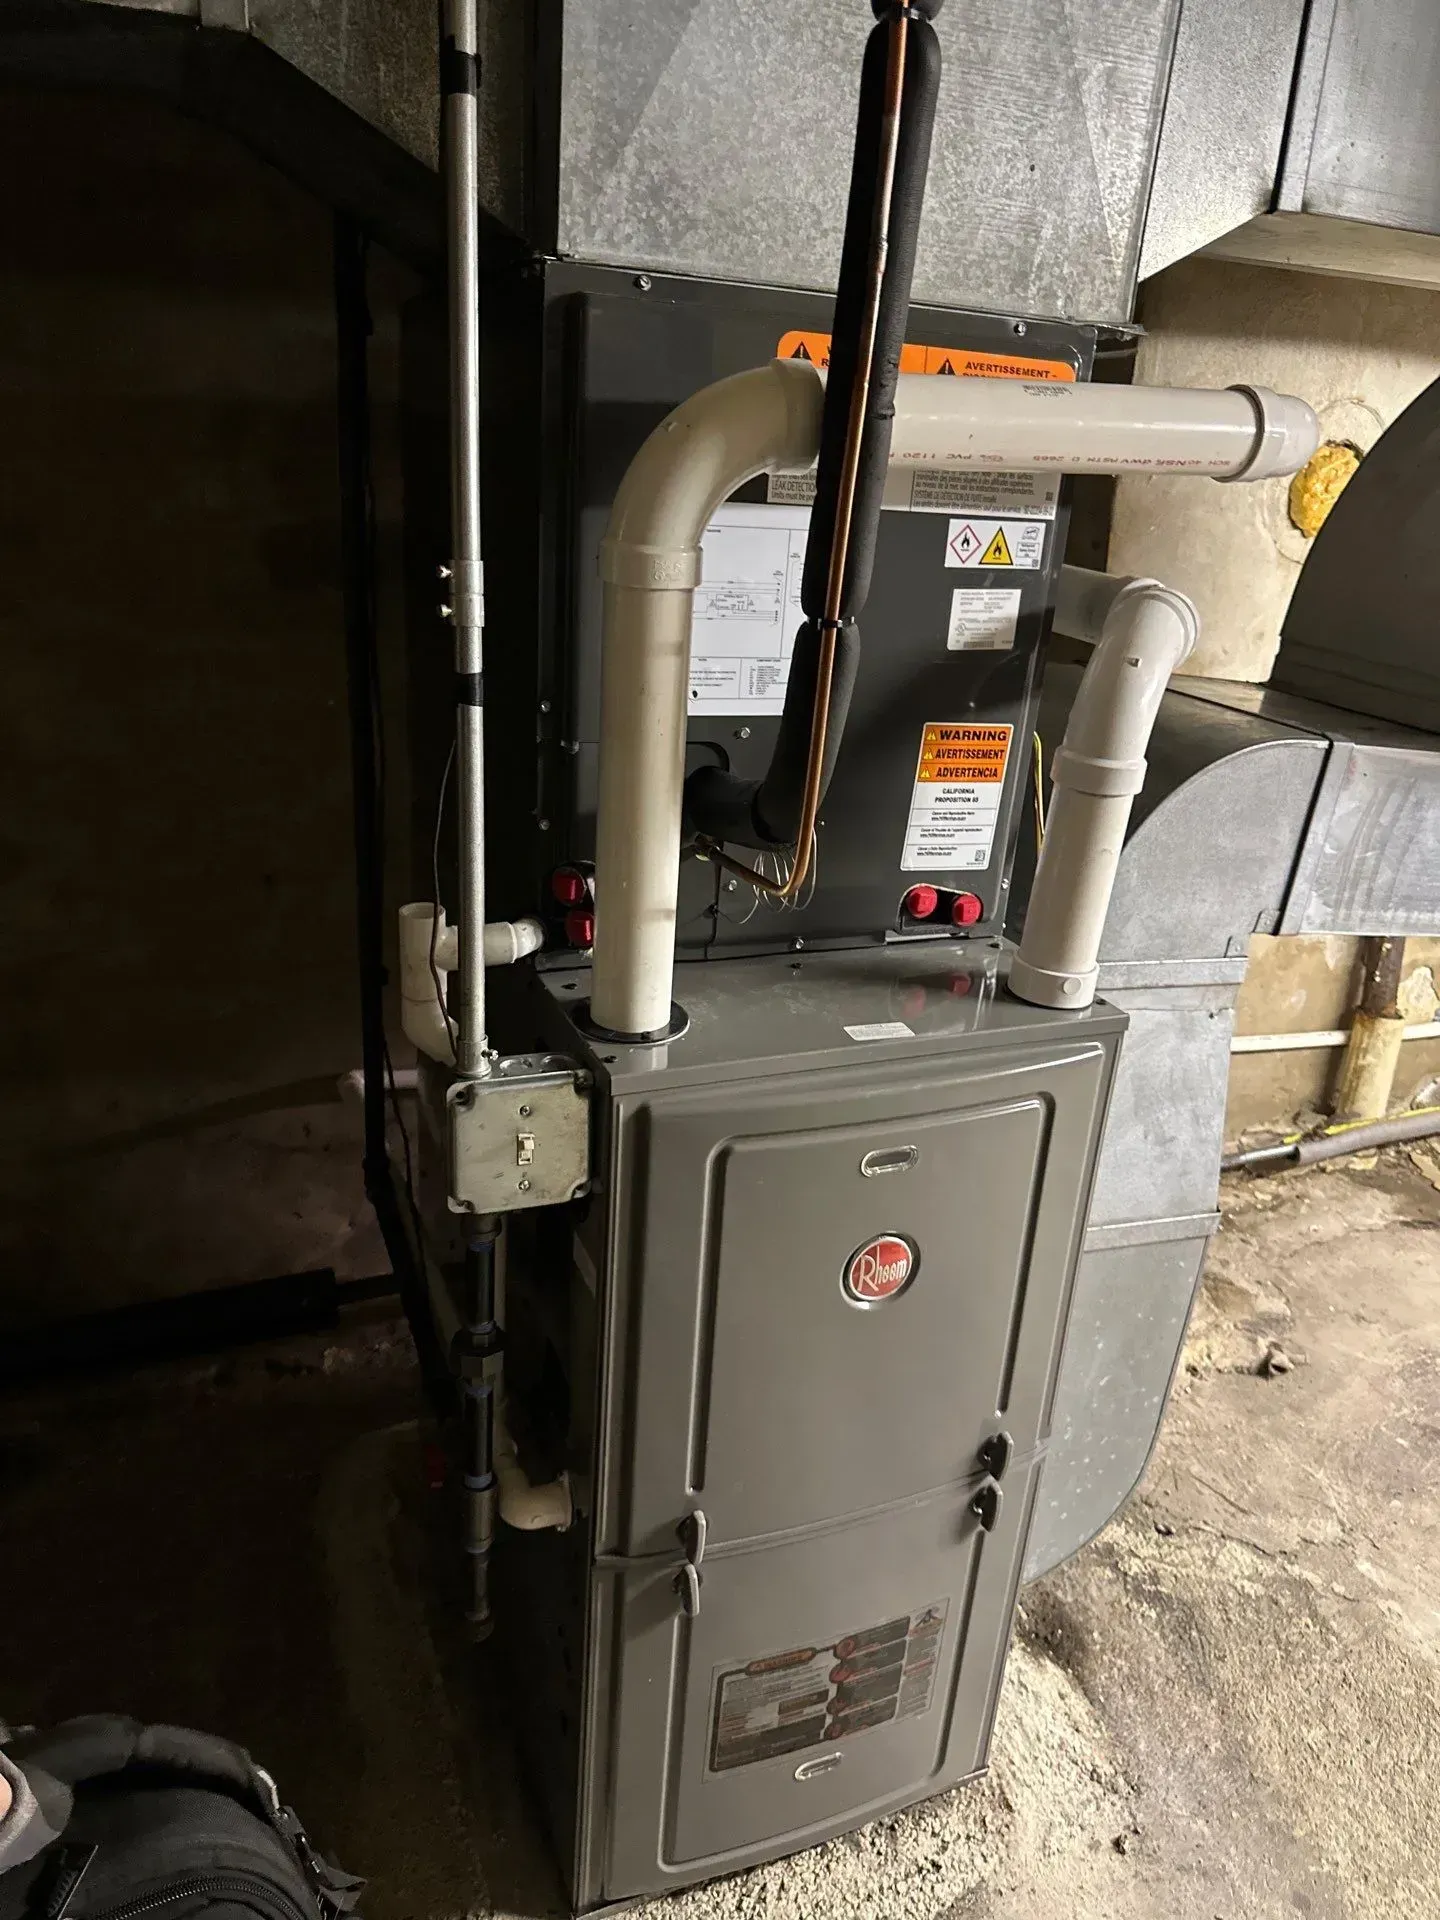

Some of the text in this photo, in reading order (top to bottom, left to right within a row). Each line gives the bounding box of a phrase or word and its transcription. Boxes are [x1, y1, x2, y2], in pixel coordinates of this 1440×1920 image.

[965, 361, 1050, 378] AVERTISSEMENT
[772, 480, 816, 493] LEAK DETECTIO
[940, 729, 1007, 741] WARNING
[935, 748, 1005, 760] AVERTISSEMENT
[935, 767, 998, 778] ADVERTENCIA
[857, 1245, 908, 1292] Rheem
